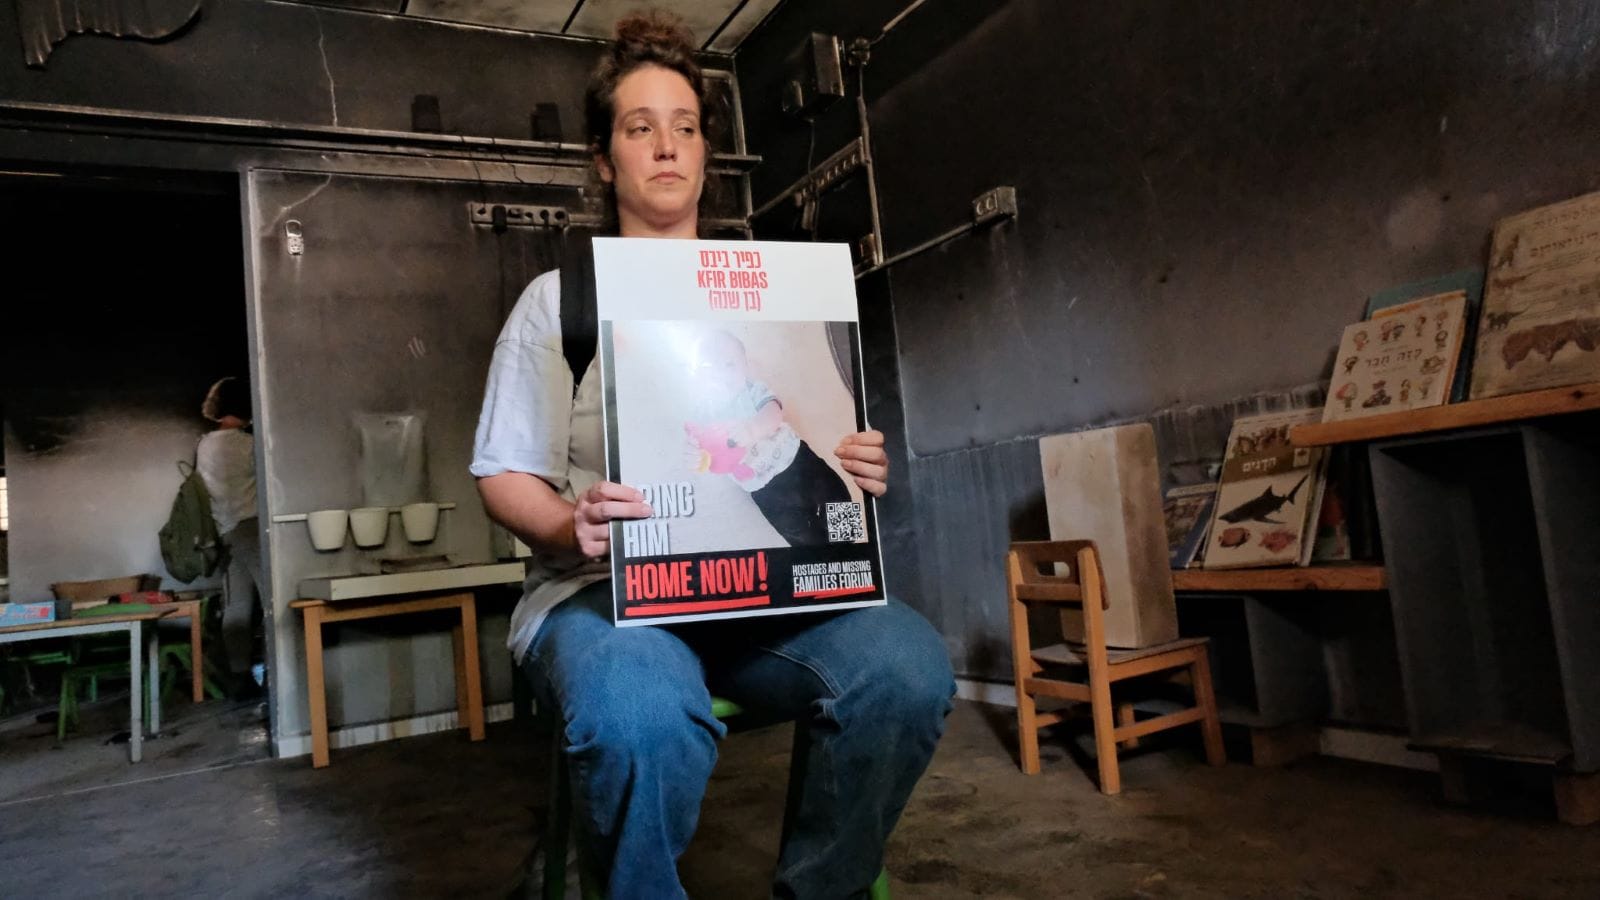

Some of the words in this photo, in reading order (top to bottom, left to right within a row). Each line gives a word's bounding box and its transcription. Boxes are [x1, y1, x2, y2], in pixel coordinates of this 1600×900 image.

[699, 250, 730, 268] ביבס
[732, 251, 761, 268] כפיר
[697, 270, 726, 288] KFIR
[729, 270, 768, 289] BIBAS
[708, 289, 740, 311] שנה)
[743, 290, 761, 312] (בן
[636, 482, 696, 518] RING
[623, 520, 670, 558] HIM
[625, 561, 694, 600] HOME
[700, 551, 768, 595] NOW!
[792, 563, 827, 576] HOSTAGES
[828, 561, 841, 573] AND
[842, 560, 871, 573] MISSING
[793, 574, 837, 593] FAMILIES
[839, 572, 873, 590] FORUM
